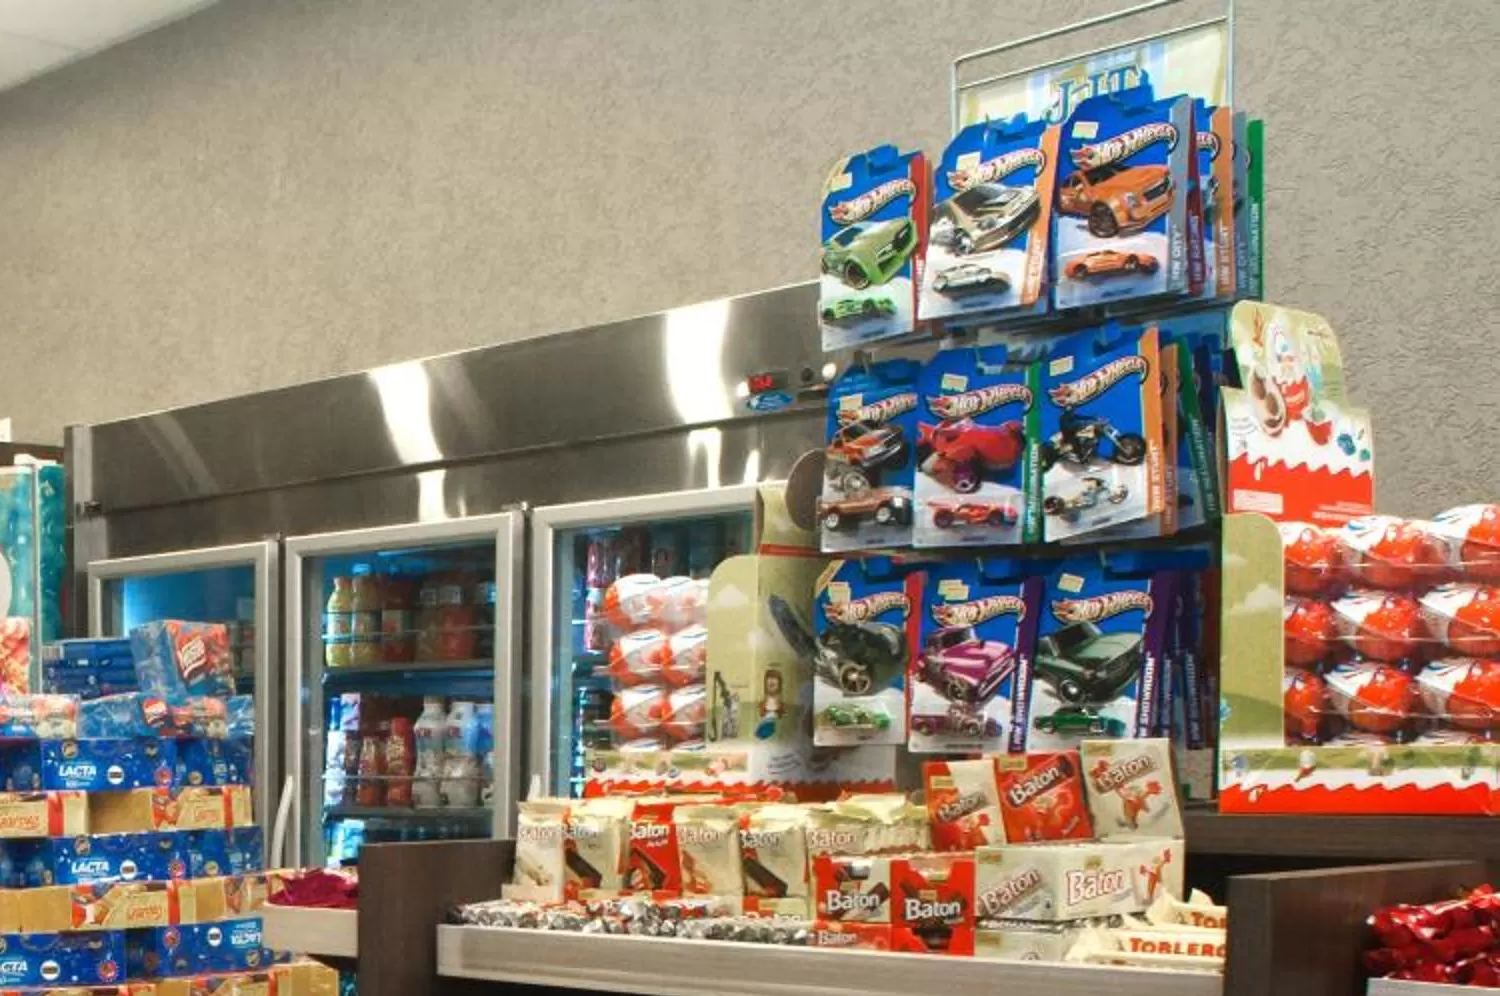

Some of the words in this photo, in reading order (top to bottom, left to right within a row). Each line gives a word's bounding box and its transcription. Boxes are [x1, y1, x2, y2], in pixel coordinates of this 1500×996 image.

[59, 765, 97, 777] LACTA
[1008, 764, 1061, 806] Baton
[1100, 754, 1150, 789] Baton
[72, 861, 109, 873] LACTA
[826, 889, 880, 912] Baton
[982, 868, 1041, 916] Baton
[1065, 868, 1126, 906] Baton
[905, 898, 961, 920] Baton
